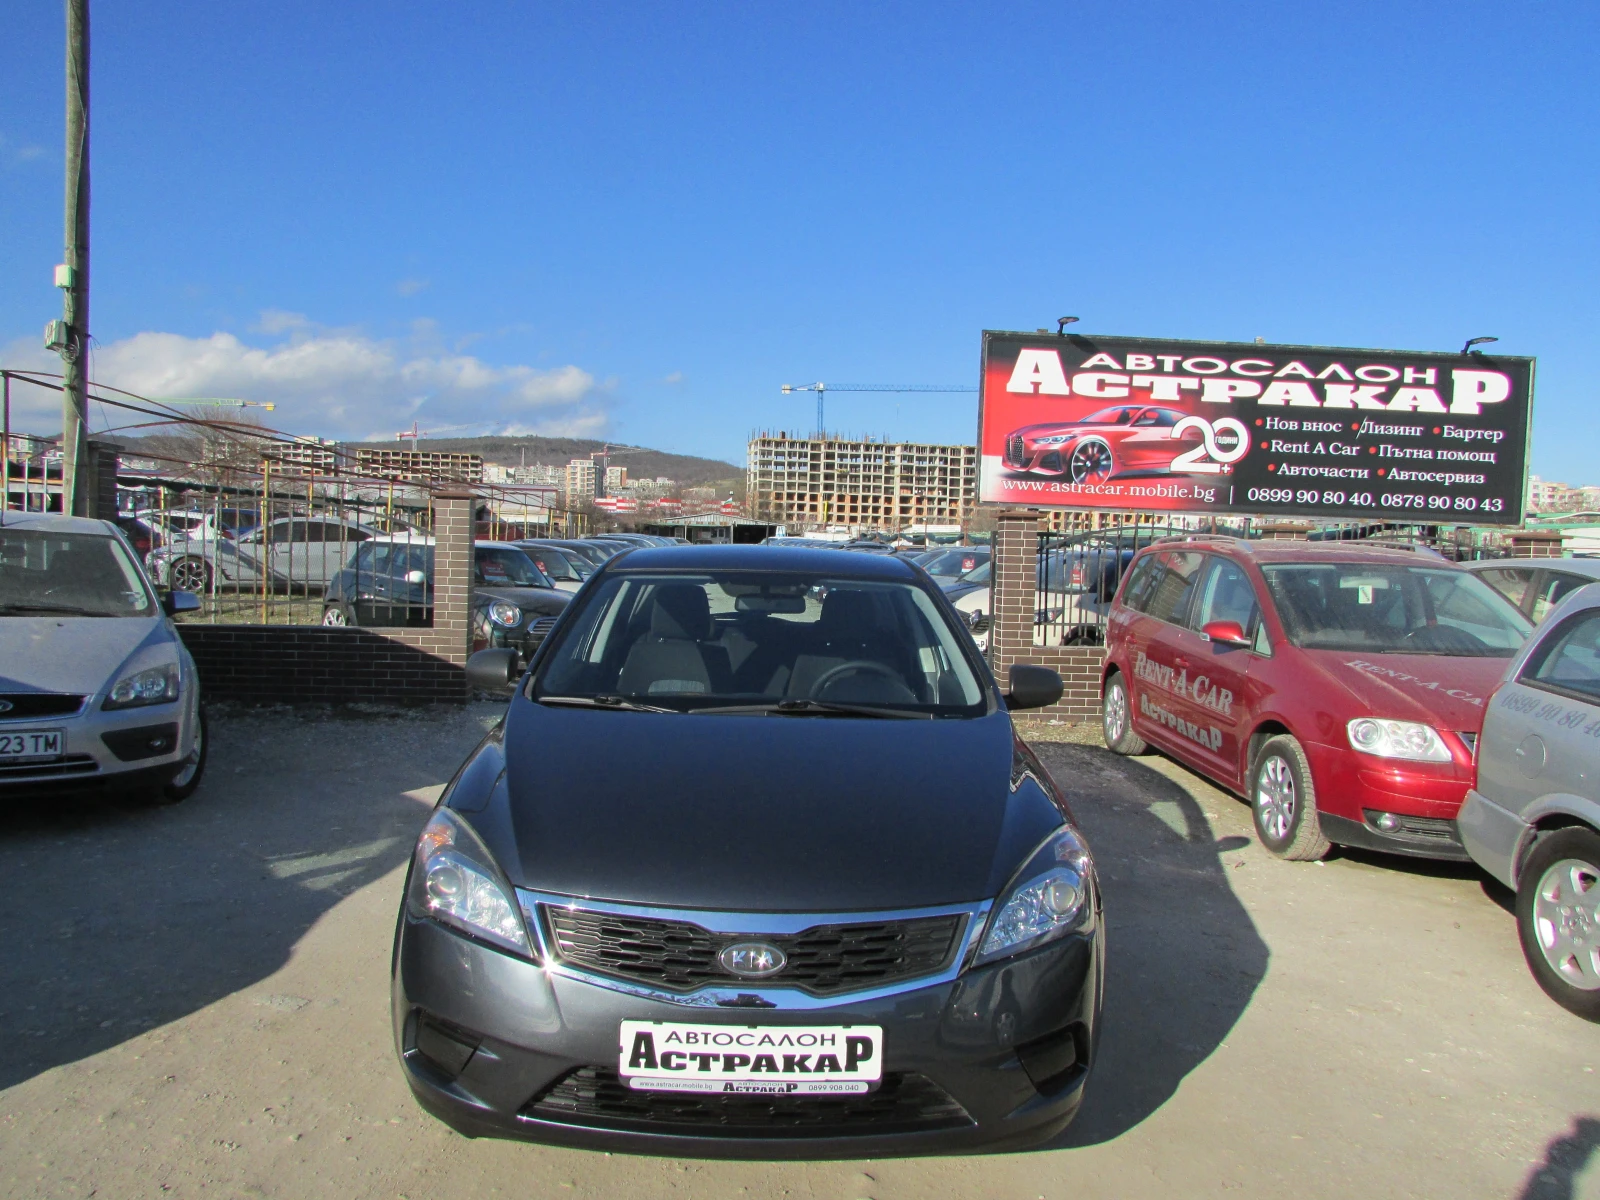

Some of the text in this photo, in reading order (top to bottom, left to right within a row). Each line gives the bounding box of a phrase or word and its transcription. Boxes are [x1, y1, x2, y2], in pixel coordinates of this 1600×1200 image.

[1079, 352, 1437, 385] АВТОСАЛОН
[1006, 348, 1511, 415] АСТРАКАР
[1265, 417, 1342, 433] Нов внос
[1442, 426, 1504, 443] Бартер
[1270, 440, 1360, 456] Rent A Car
[1379, 445, 1496, 465] Пътна помощ
[1277, 463, 1369, 479] Авточасти
[1387, 468, 1484, 486] Автосервиз
[1002, 479, 1215, 503] www.astracar.mobile.bg
[1247, 488, 1503, 512] 0899 90 80 40, 0878 90 80 43
[1134, 651, 1233, 715] RENT-A-CAR
[1344, 660, 1484, 707] RENT-A-CA
[1140, 693, 1223, 752] АСТРАКАР
[1557, 710, 1587, 729] 80
[31, 734, 58, 753] TM
[732, 950, 774, 969] KIA
[665, 1030, 836, 1047] АВТОСАЛОН
[628, 1031, 874, 1073] АСТРАКАР
[640, 1080, 713, 1090] www.astracar.mobile.bg
[723, 1081, 799, 1093] АСТРАКАР
